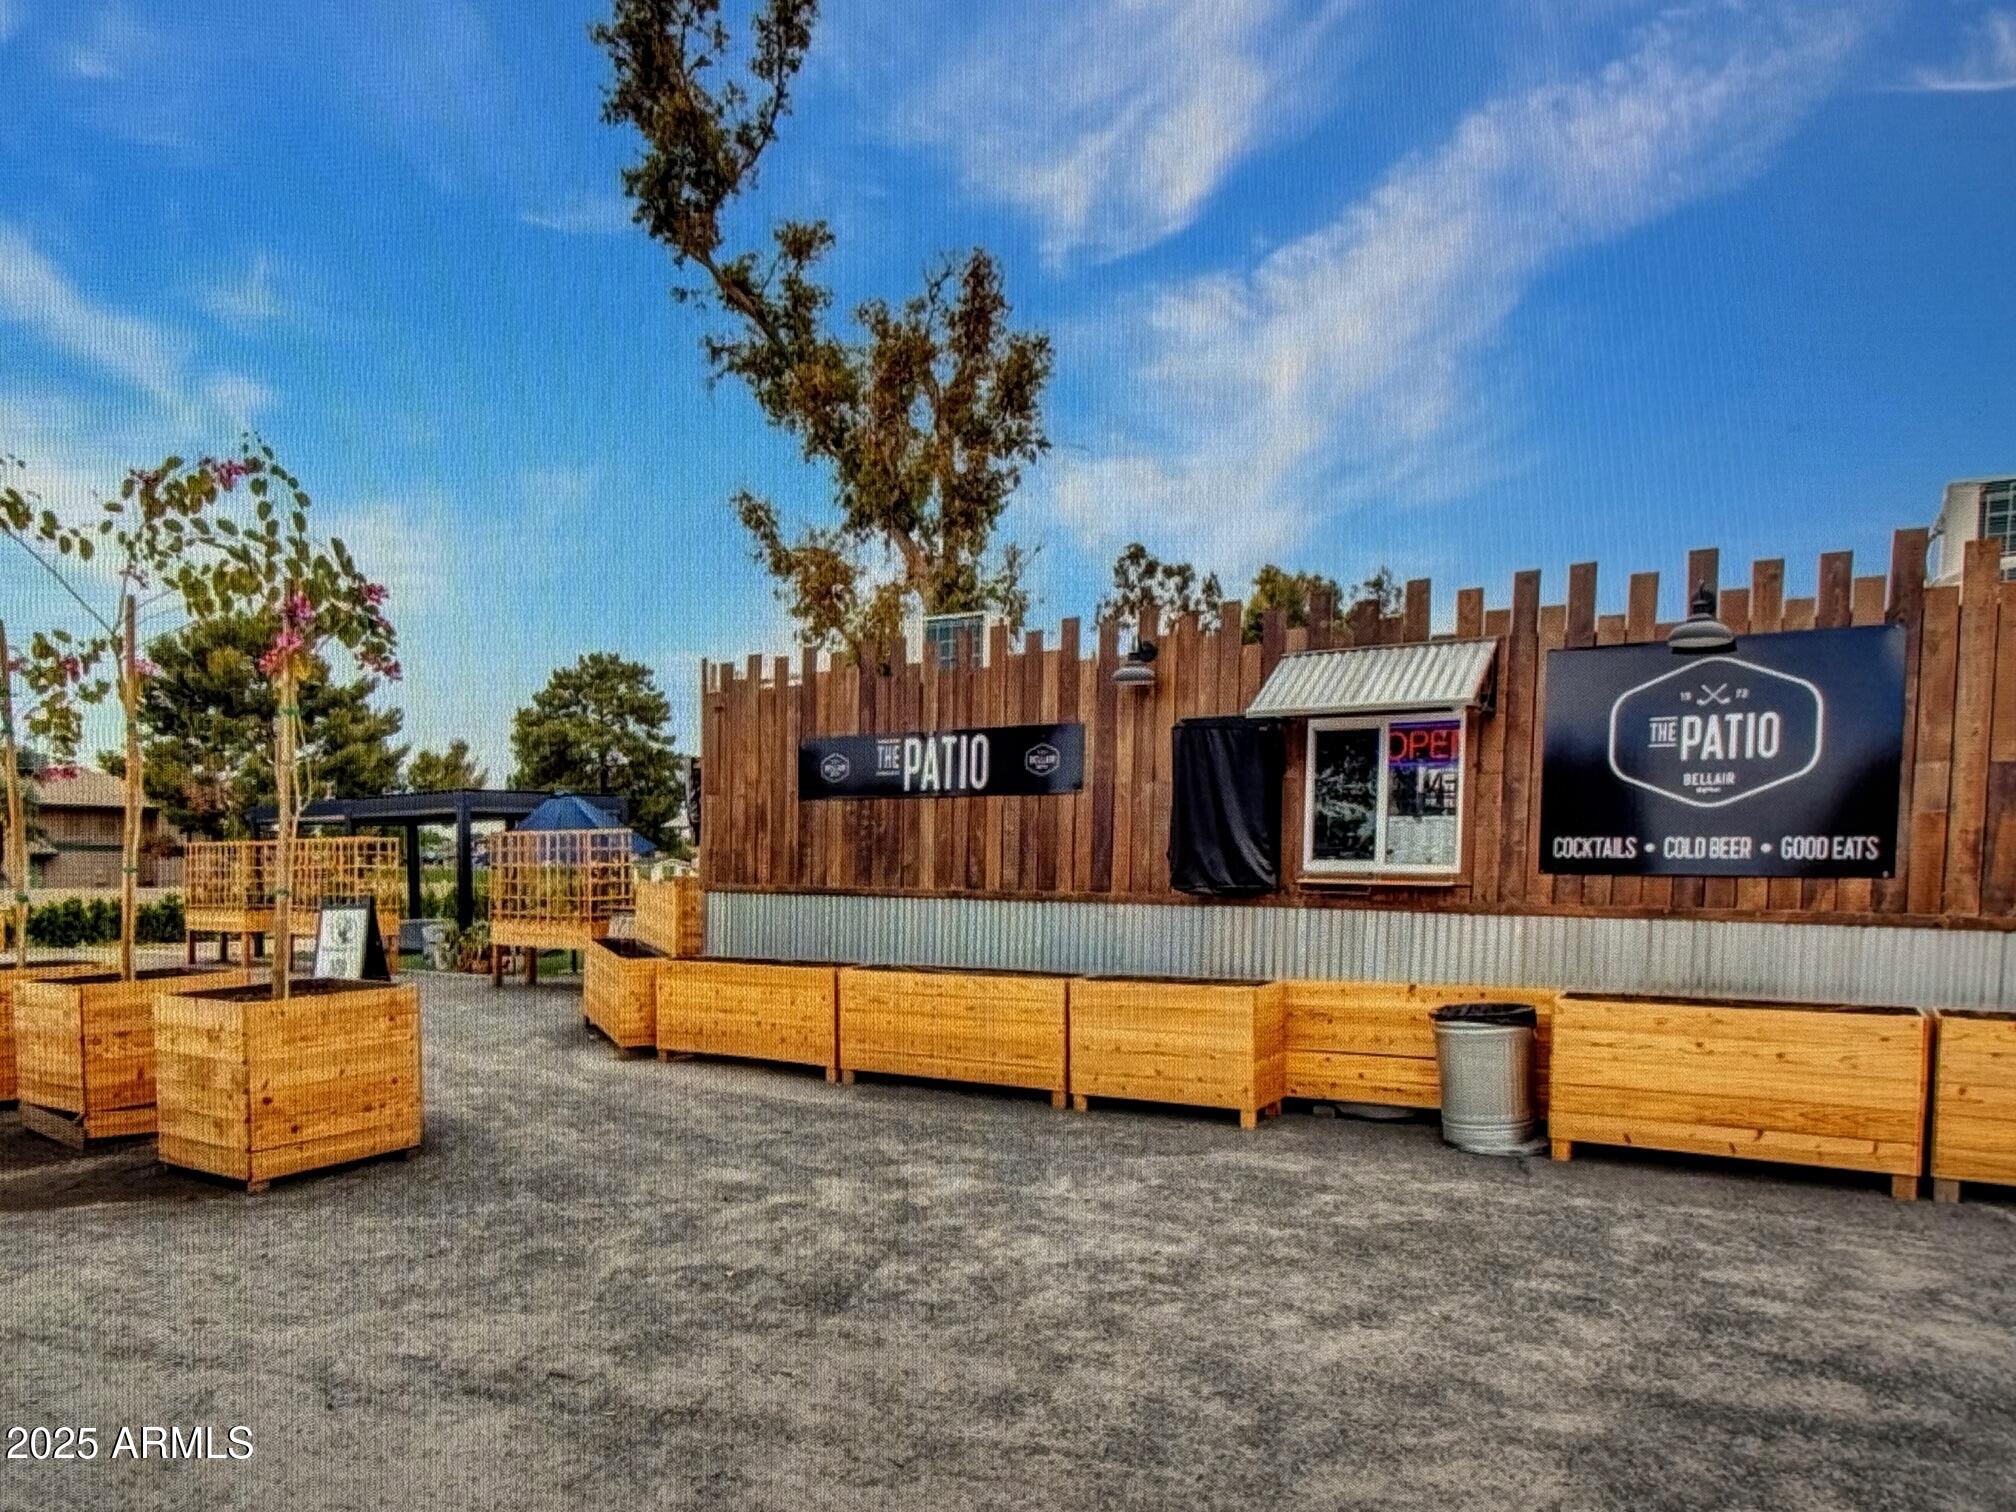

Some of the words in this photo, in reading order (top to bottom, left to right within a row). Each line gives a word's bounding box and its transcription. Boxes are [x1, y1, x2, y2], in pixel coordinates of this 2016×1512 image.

[1650, 721, 1677, 742] THE
[1680, 711, 1780, 761] PATIO
[877, 745, 899, 769] THE
[903, 733, 989, 792] PATIO
[1682, 771, 1736, 786] BELLAIR
[1553, 836, 1638, 859] COCKTAILS
[1663, 836, 1706, 859] COLD
[1709, 836, 1752, 859] BEER
[1780, 835, 1829, 860] GOOD
[1832, 836, 1879, 860] EATS
